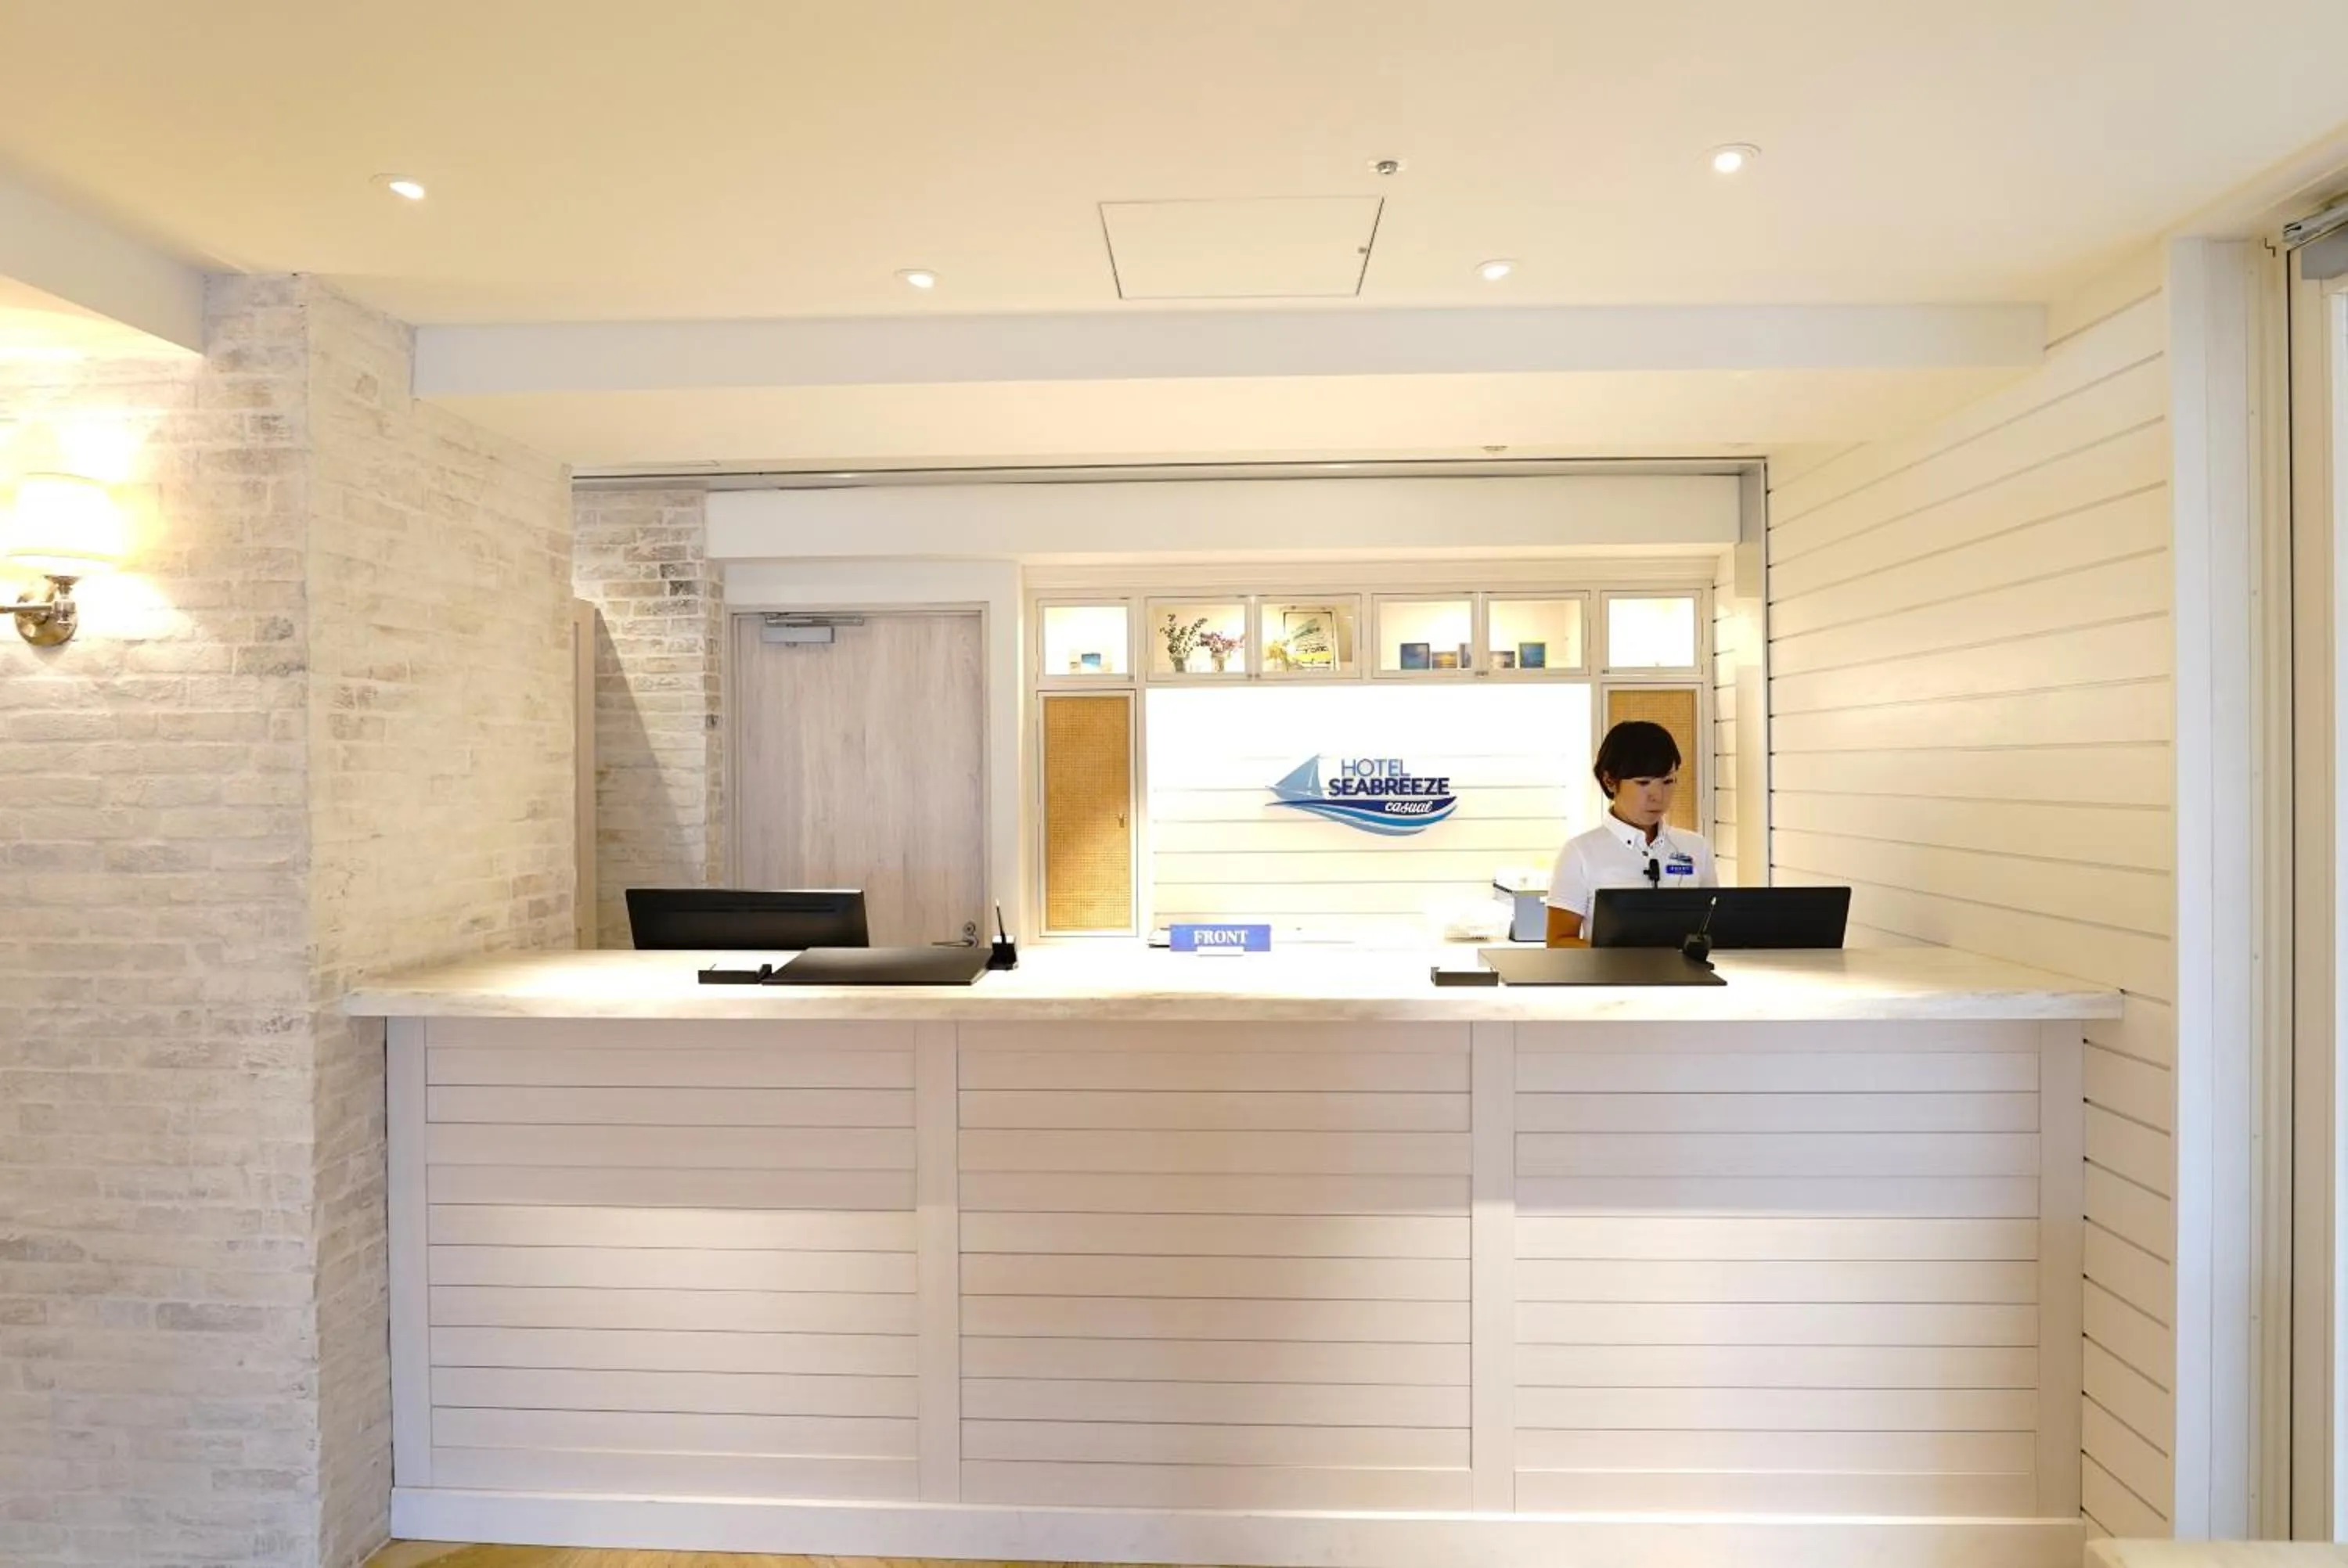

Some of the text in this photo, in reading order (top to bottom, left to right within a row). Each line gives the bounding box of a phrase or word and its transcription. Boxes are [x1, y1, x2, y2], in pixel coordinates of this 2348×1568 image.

[1341, 758, 1411, 777] HOTEL
[1328, 777, 1450, 797] SEABREEZE
[1385, 800, 1433, 814] casual
[1193, 930, 1249, 944] FRONT
